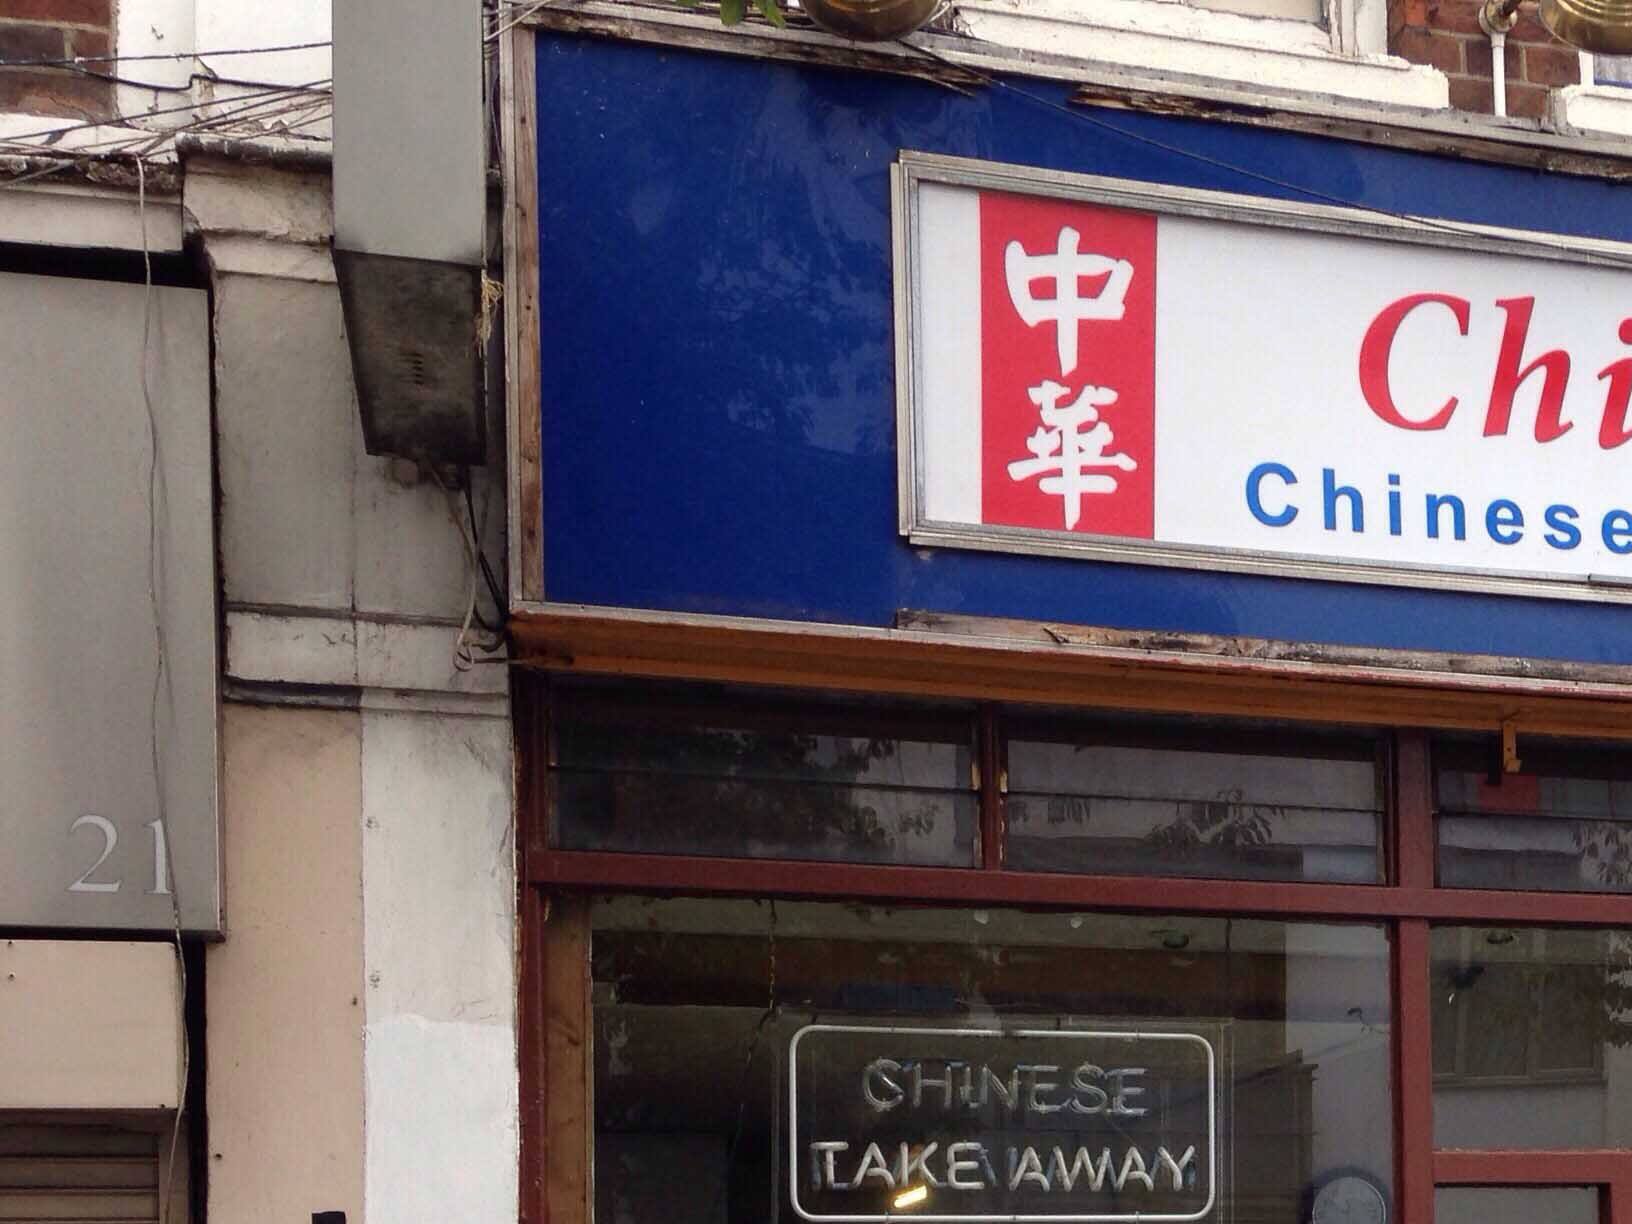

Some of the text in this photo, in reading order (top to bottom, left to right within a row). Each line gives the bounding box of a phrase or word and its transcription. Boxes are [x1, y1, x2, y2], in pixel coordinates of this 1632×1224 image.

[1004, 226, 1137, 531] 中華
[66, 814, 174, 894] 21
[863, 1058, 1148, 1116] CHINESE
[811, 1140, 1195, 1192] TAKE AWAY
